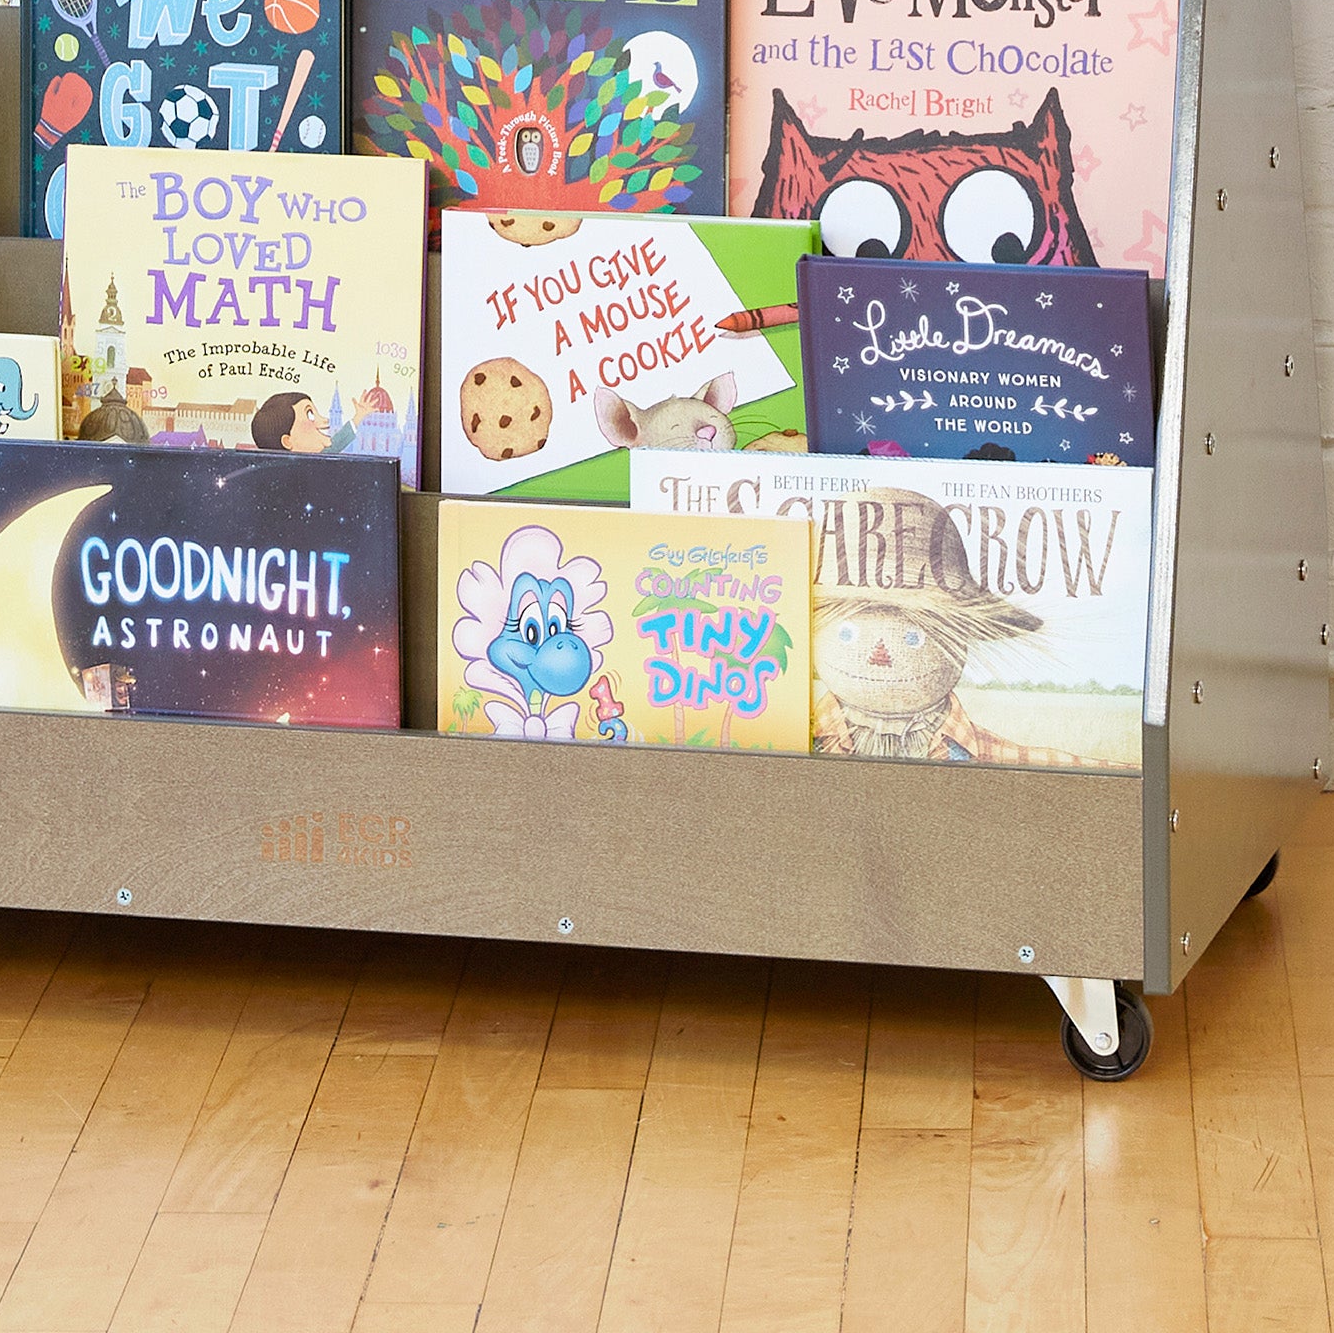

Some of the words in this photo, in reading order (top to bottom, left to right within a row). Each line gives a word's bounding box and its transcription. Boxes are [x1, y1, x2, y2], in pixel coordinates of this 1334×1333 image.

[752, 38, 798, 64] and
[809, 34, 857, 69] the
[870, 36, 936, 73] Last
[947, 39, 1115, 78] Chocolate
[847, 87, 916, 116] Rachel
[924, 88, 994, 119] Bright
[116, 180, 146, 199] The
[150, 171, 274, 224] BOY
[277, 192, 367, 224] WHO
[162, 226, 313, 272] LOVED
[146, 269, 341, 332] MATH
[486, 283, 518, 330] IF
[523, 261, 582, 312] YOU
[588, 237, 666, 291] GIVE
[556, 319, 572, 356] A
[579, 280, 691, 344] MOUSE
[852, 299, 951, 365] Little
[952, 296, 1109, 380] Dreamers
[163, 347, 196, 365] The
[201, 340, 297, 359] Improbable
[302, 349, 337, 373] Life
[198, 364, 214, 379] of
[219, 362, 253, 376] Paul
[568, 368, 587, 403] A
[598, 315, 716, 389] COOKIE
[899, 367, 991, 385] VISIONARY
[998, 372, 1062, 389] WOMEN
[949, 394, 1018, 411] AROUND
[934, 417, 968, 432] THE
[973, 418, 1034, 435] WORLD
[774, 474, 816, 491] BETH
[819, 476, 872, 494] FERRY
[942, 481, 976, 499] THE
[979, 483, 1014, 500] FAN
[1016, 485, 1104, 504] BROTHERS
[659, 476, 720, 514] THE
[726, 476, 1121, 599] ARECROW
[80, 536, 352, 621] GOODNIGHT,
[635, 569, 783, 604] COUNTING
[92, 616, 333, 658] ASTRONAUT
[637, 606, 777, 663] TINY
[644, 657, 780, 720] DINOS
[338, 813, 412, 846] ECR
